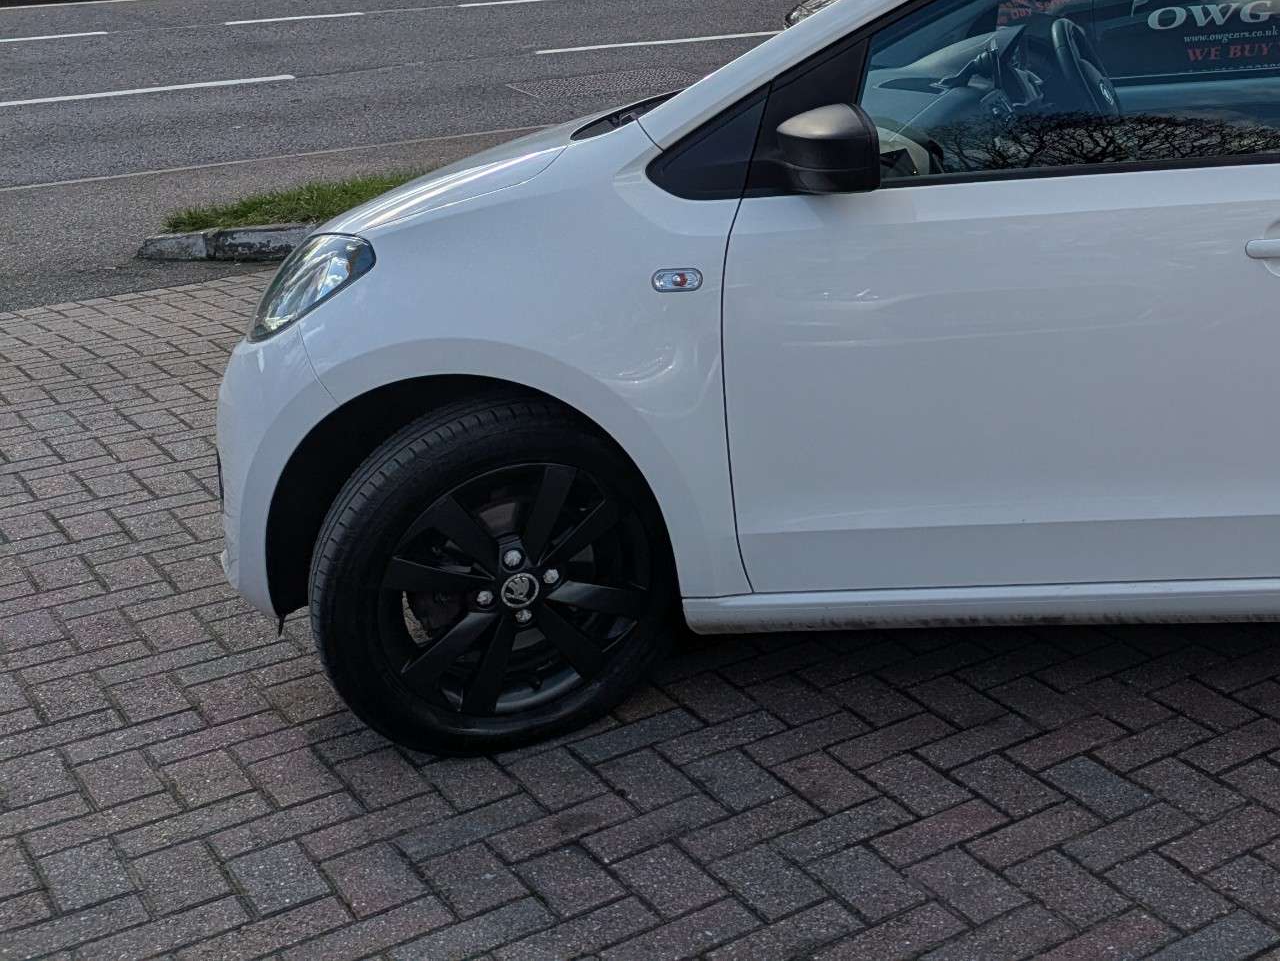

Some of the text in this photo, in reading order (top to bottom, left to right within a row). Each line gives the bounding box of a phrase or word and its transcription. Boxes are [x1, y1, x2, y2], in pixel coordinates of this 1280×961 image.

[1147, 0, 1276, 30] OWG
[1187, 46, 1221, 62] WE
[1229, 42, 1272, 59] BUY
